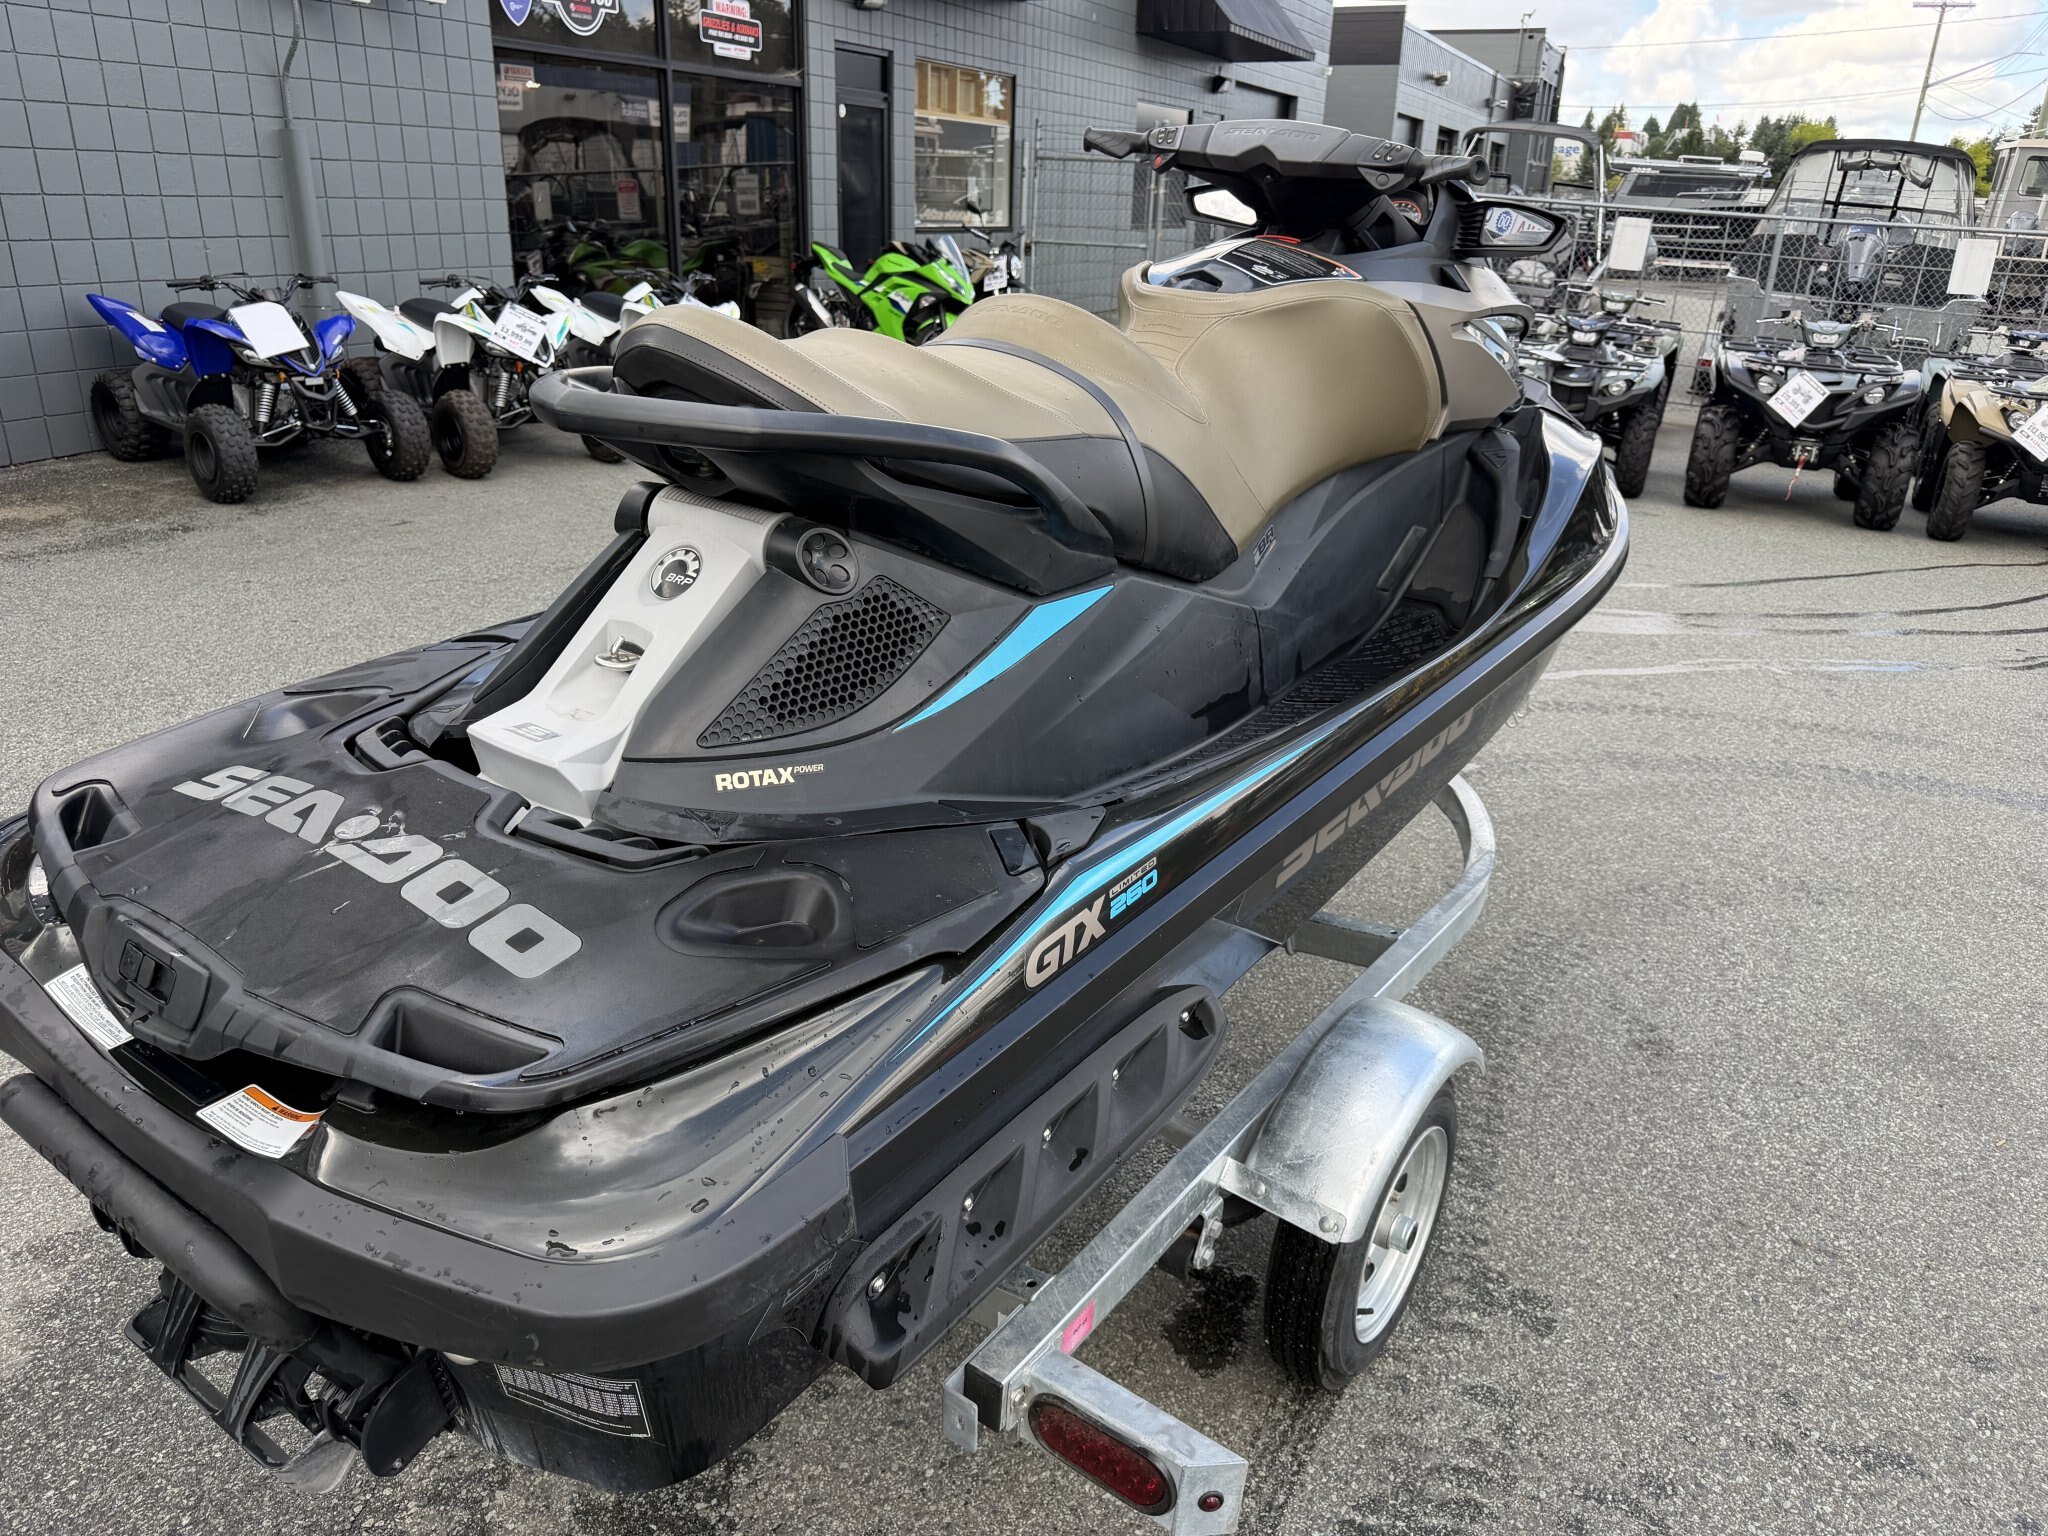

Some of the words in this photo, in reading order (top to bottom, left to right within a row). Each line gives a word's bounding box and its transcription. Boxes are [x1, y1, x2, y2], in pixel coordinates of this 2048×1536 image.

[665, 573, 693, 585] BRP
[715, 766, 795, 791] ROTAX
[794, 763, 824, 774] POWER
[1110, 858, 1156, 896] LIMITED
[1110, 869, 1157, 919] 260
[1026, 894, 1106, 988] GTX
